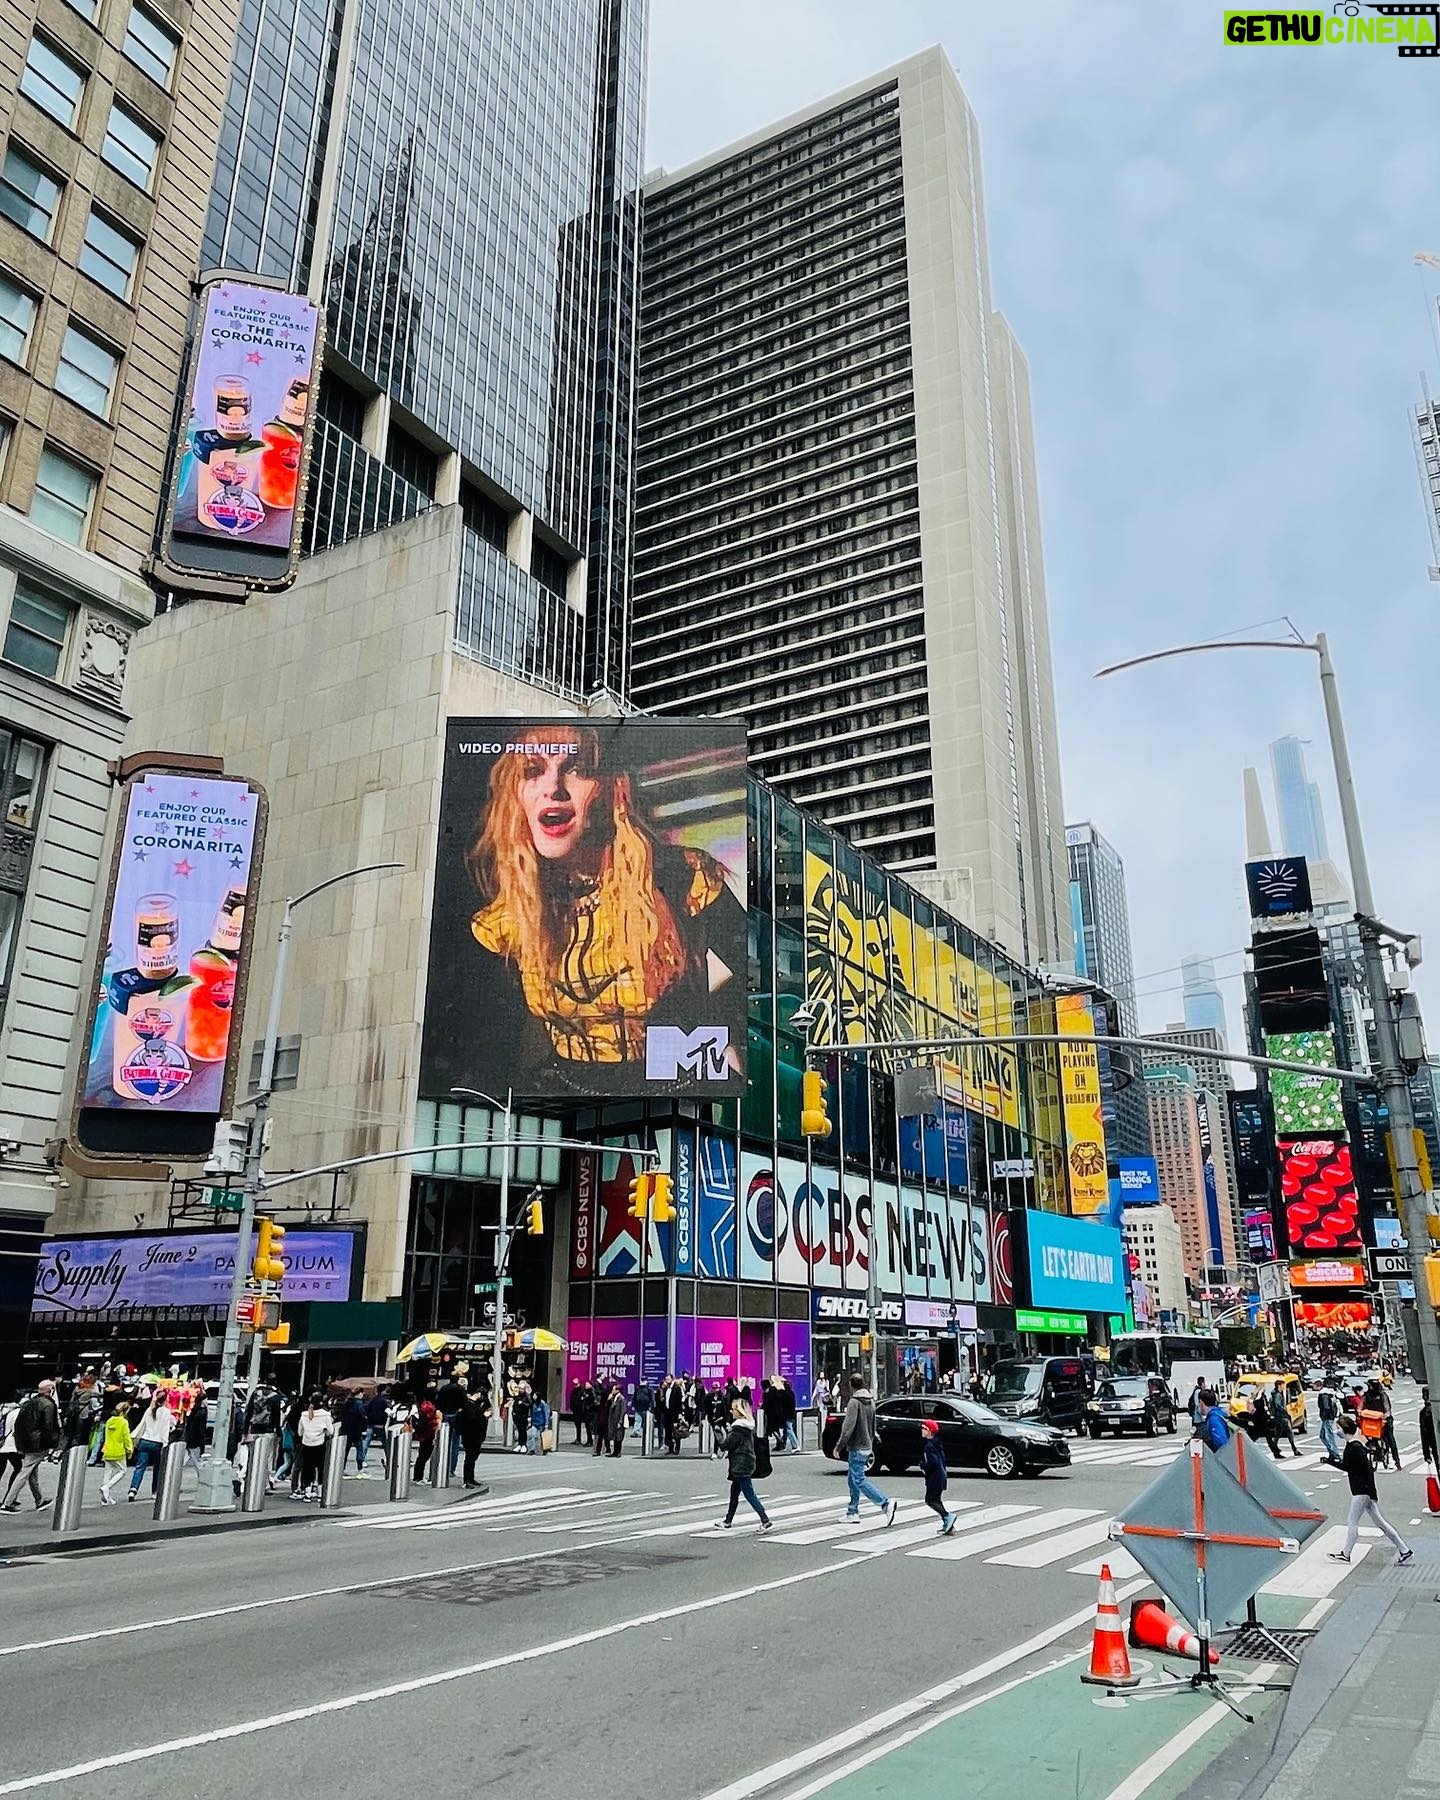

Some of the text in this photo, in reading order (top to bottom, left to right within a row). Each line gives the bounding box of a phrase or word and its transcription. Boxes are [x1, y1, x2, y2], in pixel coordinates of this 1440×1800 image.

[214, 308, 310, 333] FEATURED CLASSIC
[233, 305, 291, 322] ENJOY OUR
[247, 324, 274, 337] THE
[211, 328, 307, 353] CORONARITA
[459, 743, 578, 755] VIDEO PREMIERE
[159, 803, 227, 816] ENJOY OUR
[137, 810, 248, 827] FEATURED CLASSIC
[175, 825, 207, 838] THE
[132, 835, 244, 854] CORONARITA
[646, 1026, 730, 1081] MTV
[1063, 1054, 1096, 1069] PLAYING
[123, 1066, 190, 1083] BUBBA GUMP
[1074, 1073, 1087, 1088] ON
[1065, 1093, 1098, 1105] BROADWAY
[678, 1143, 690, 1250] CBS NEWS
[577, 1156, 591, 1256] CBS NEWS
[792, 1181, 986, 1286] CBS NEWS
[1068, 1249, 1097, 1283] EARTH
[1097, 1254, 1114, 1285] DAY
[41, 1249, 129, 1313] Supply
[138, 1242, 184, 1273] June
[184, 1245, 198, 1264] 2
[570, 1341, 589, 1356] 1515
[597, 1342, 626, 1354] FLAGSHIP
[700, 1342, 724, 1354] FLAGSHIP
[596, 1354, 616, 1366] RETAIL
[616, 1354, 636, 1366] SPACE
[700, 1366, 711, 1378] FOR
